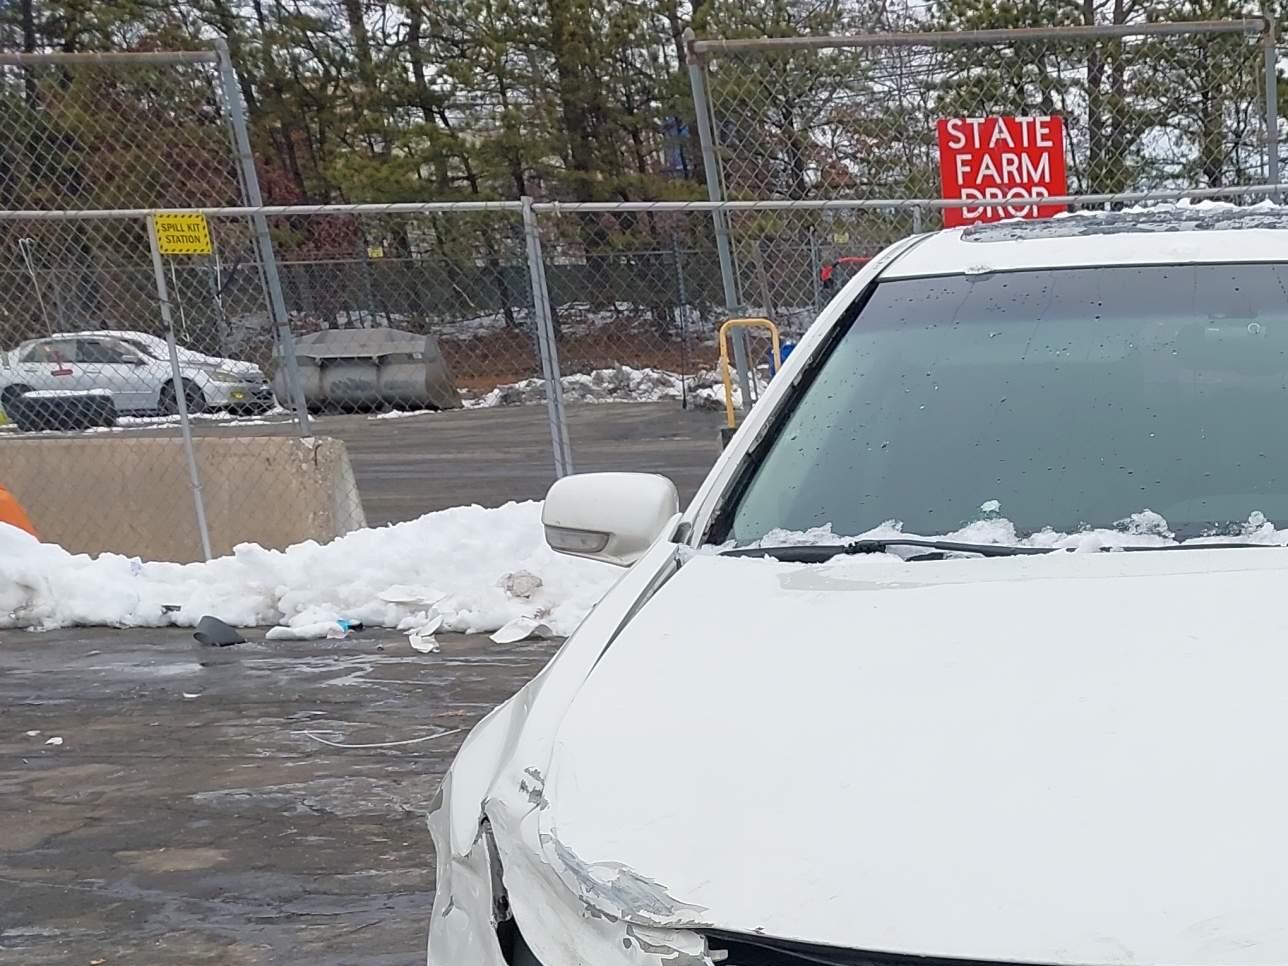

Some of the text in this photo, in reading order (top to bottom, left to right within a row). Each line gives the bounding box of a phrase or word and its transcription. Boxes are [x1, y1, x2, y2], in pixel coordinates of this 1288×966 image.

[946, 117, 1053, 150] STATE
[955, 152, 1050, 186] FARM
[961, 186, 1049, 219] DROP
[160, 223, 201, 233] SPILL KIT
[165, 234, 201, 244] STATION
